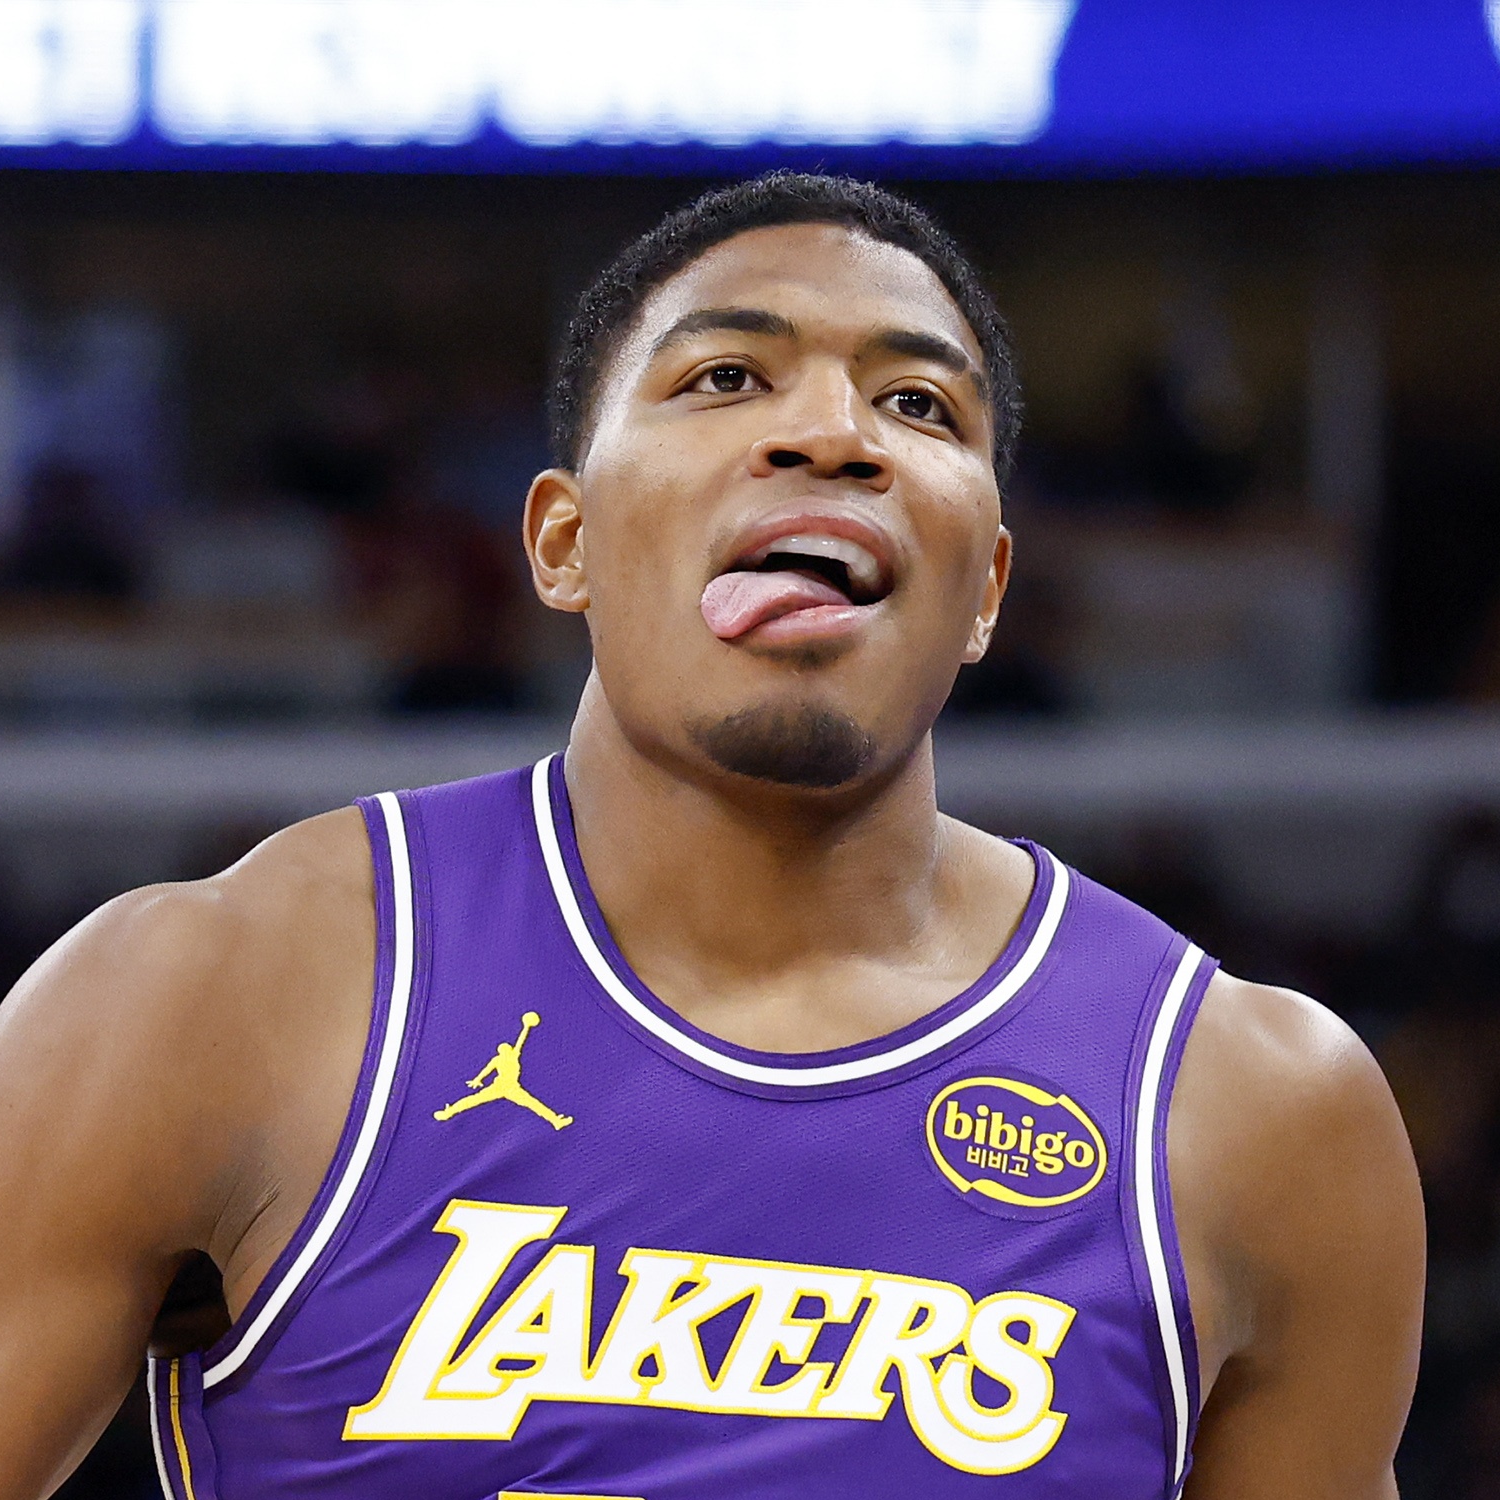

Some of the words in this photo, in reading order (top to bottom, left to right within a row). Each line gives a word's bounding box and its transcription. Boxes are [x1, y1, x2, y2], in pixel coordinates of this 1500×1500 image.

[943, 1100, 1096, 1175] bibigo
[965, 1145, 1030, 1178] 비비고
[342, 1198, 1077, 1476] LAKERS
